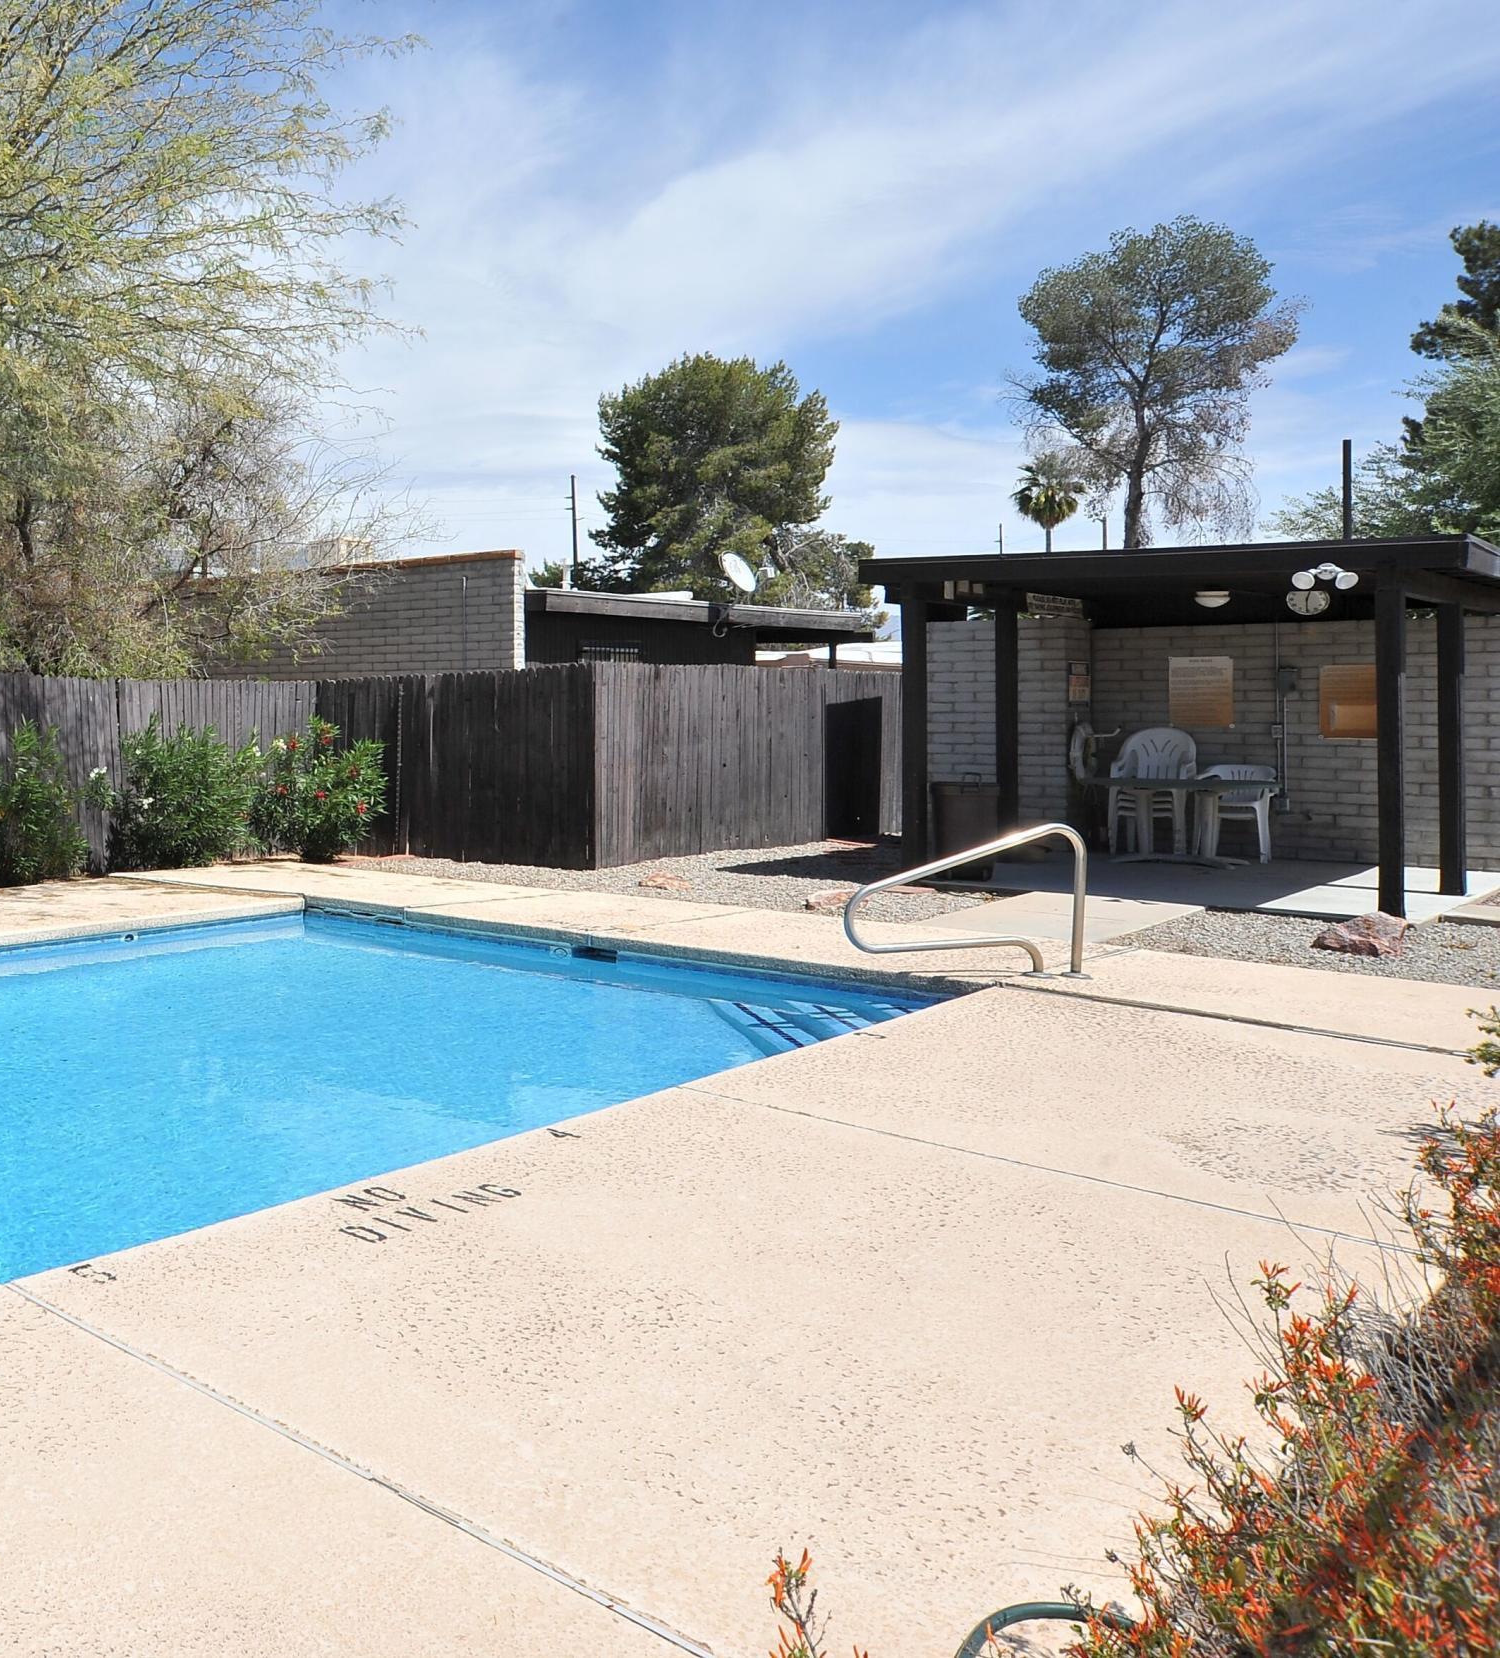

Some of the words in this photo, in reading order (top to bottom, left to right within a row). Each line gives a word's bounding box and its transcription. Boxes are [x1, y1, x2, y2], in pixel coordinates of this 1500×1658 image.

[546, 1128, 582, 1138] 4
[331, 1187, 406, 1211] NO
[338, 1184, 522, 1243] DIVING
[68, 1264, 117, 1284] 5
